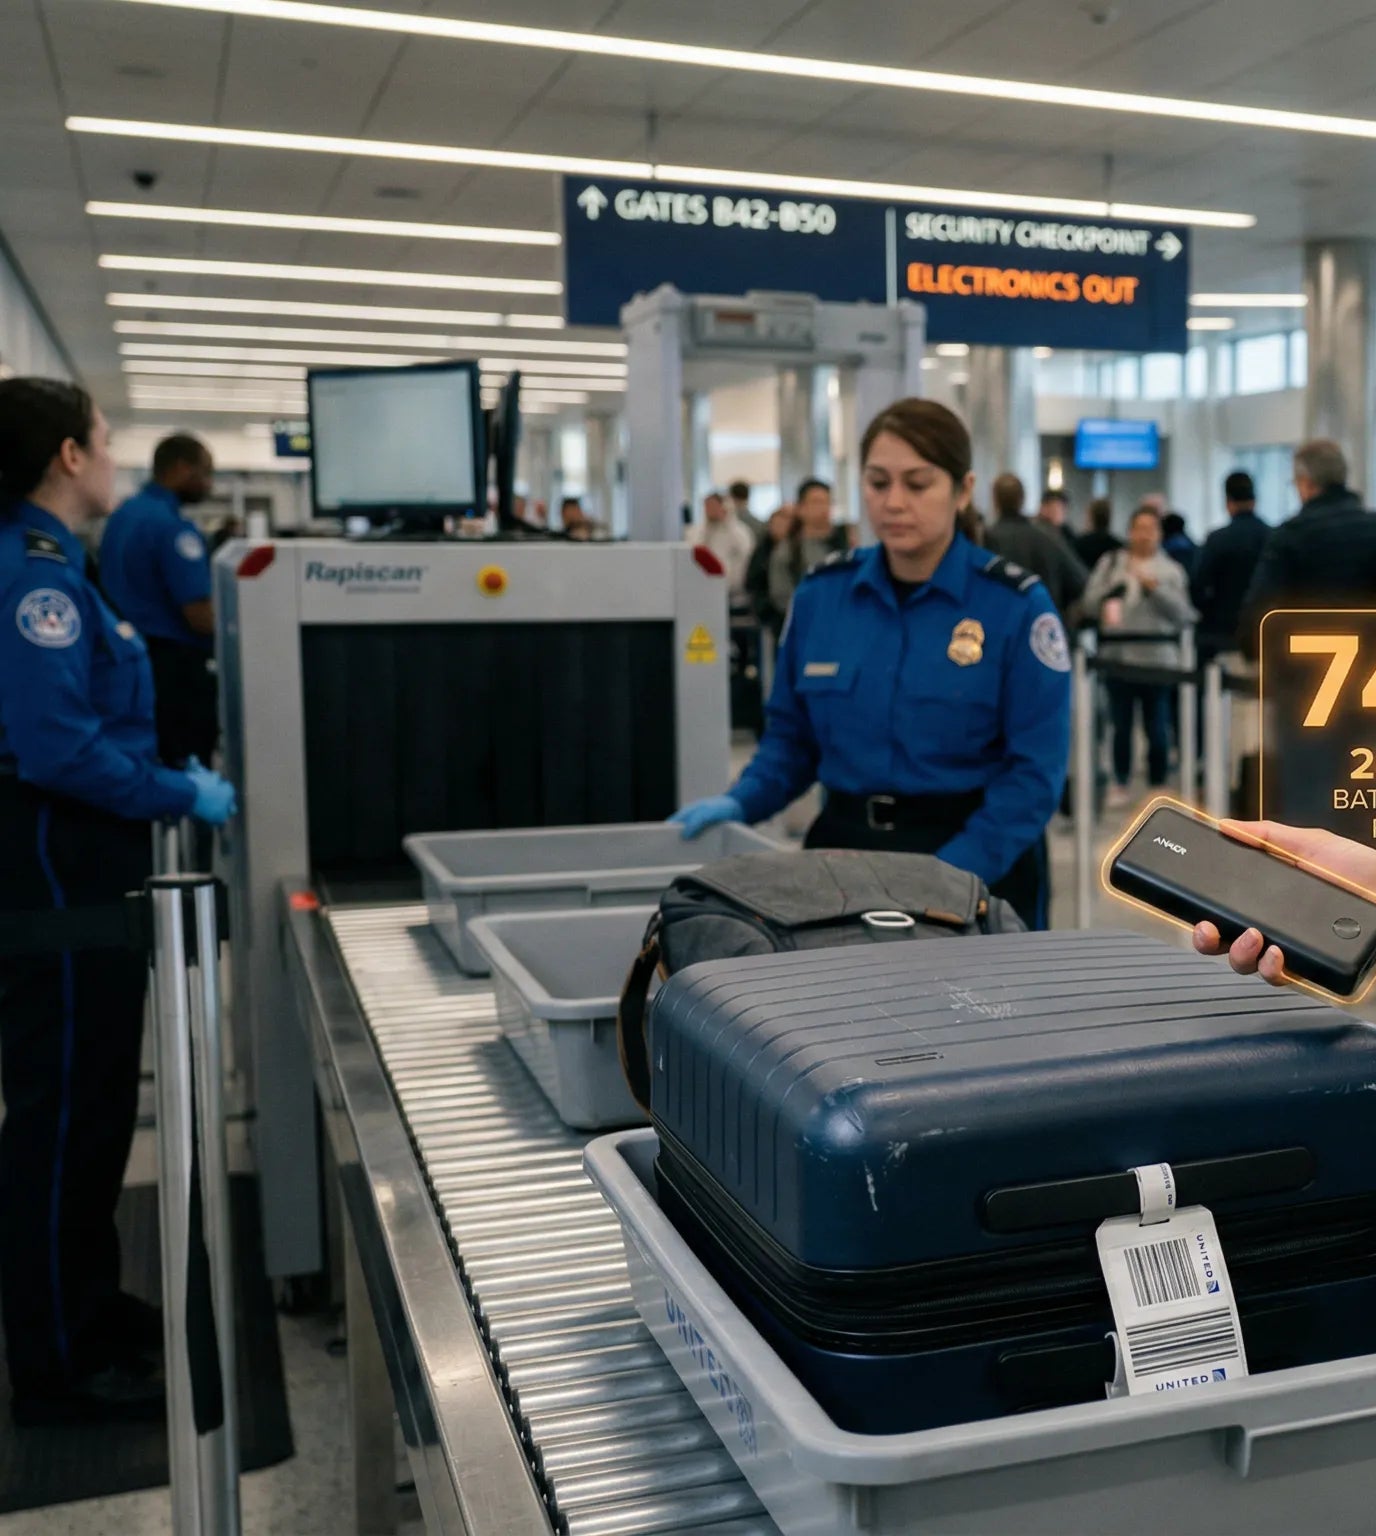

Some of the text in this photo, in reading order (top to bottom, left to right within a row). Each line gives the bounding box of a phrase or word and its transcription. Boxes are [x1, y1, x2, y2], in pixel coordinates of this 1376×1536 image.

[614, 189, 837, 236] GATES B42-B50
[905, 212, 1151, 256] SECURITY CHECKPOINT
[907, 262, 1139, 305] ELECTRONICS OUT
[305, 561, 422, 586] Rapiscan
[1196, 1234, 1214, 1278] UNITED
[1155, 1375, 1209, 1392] UNITED
